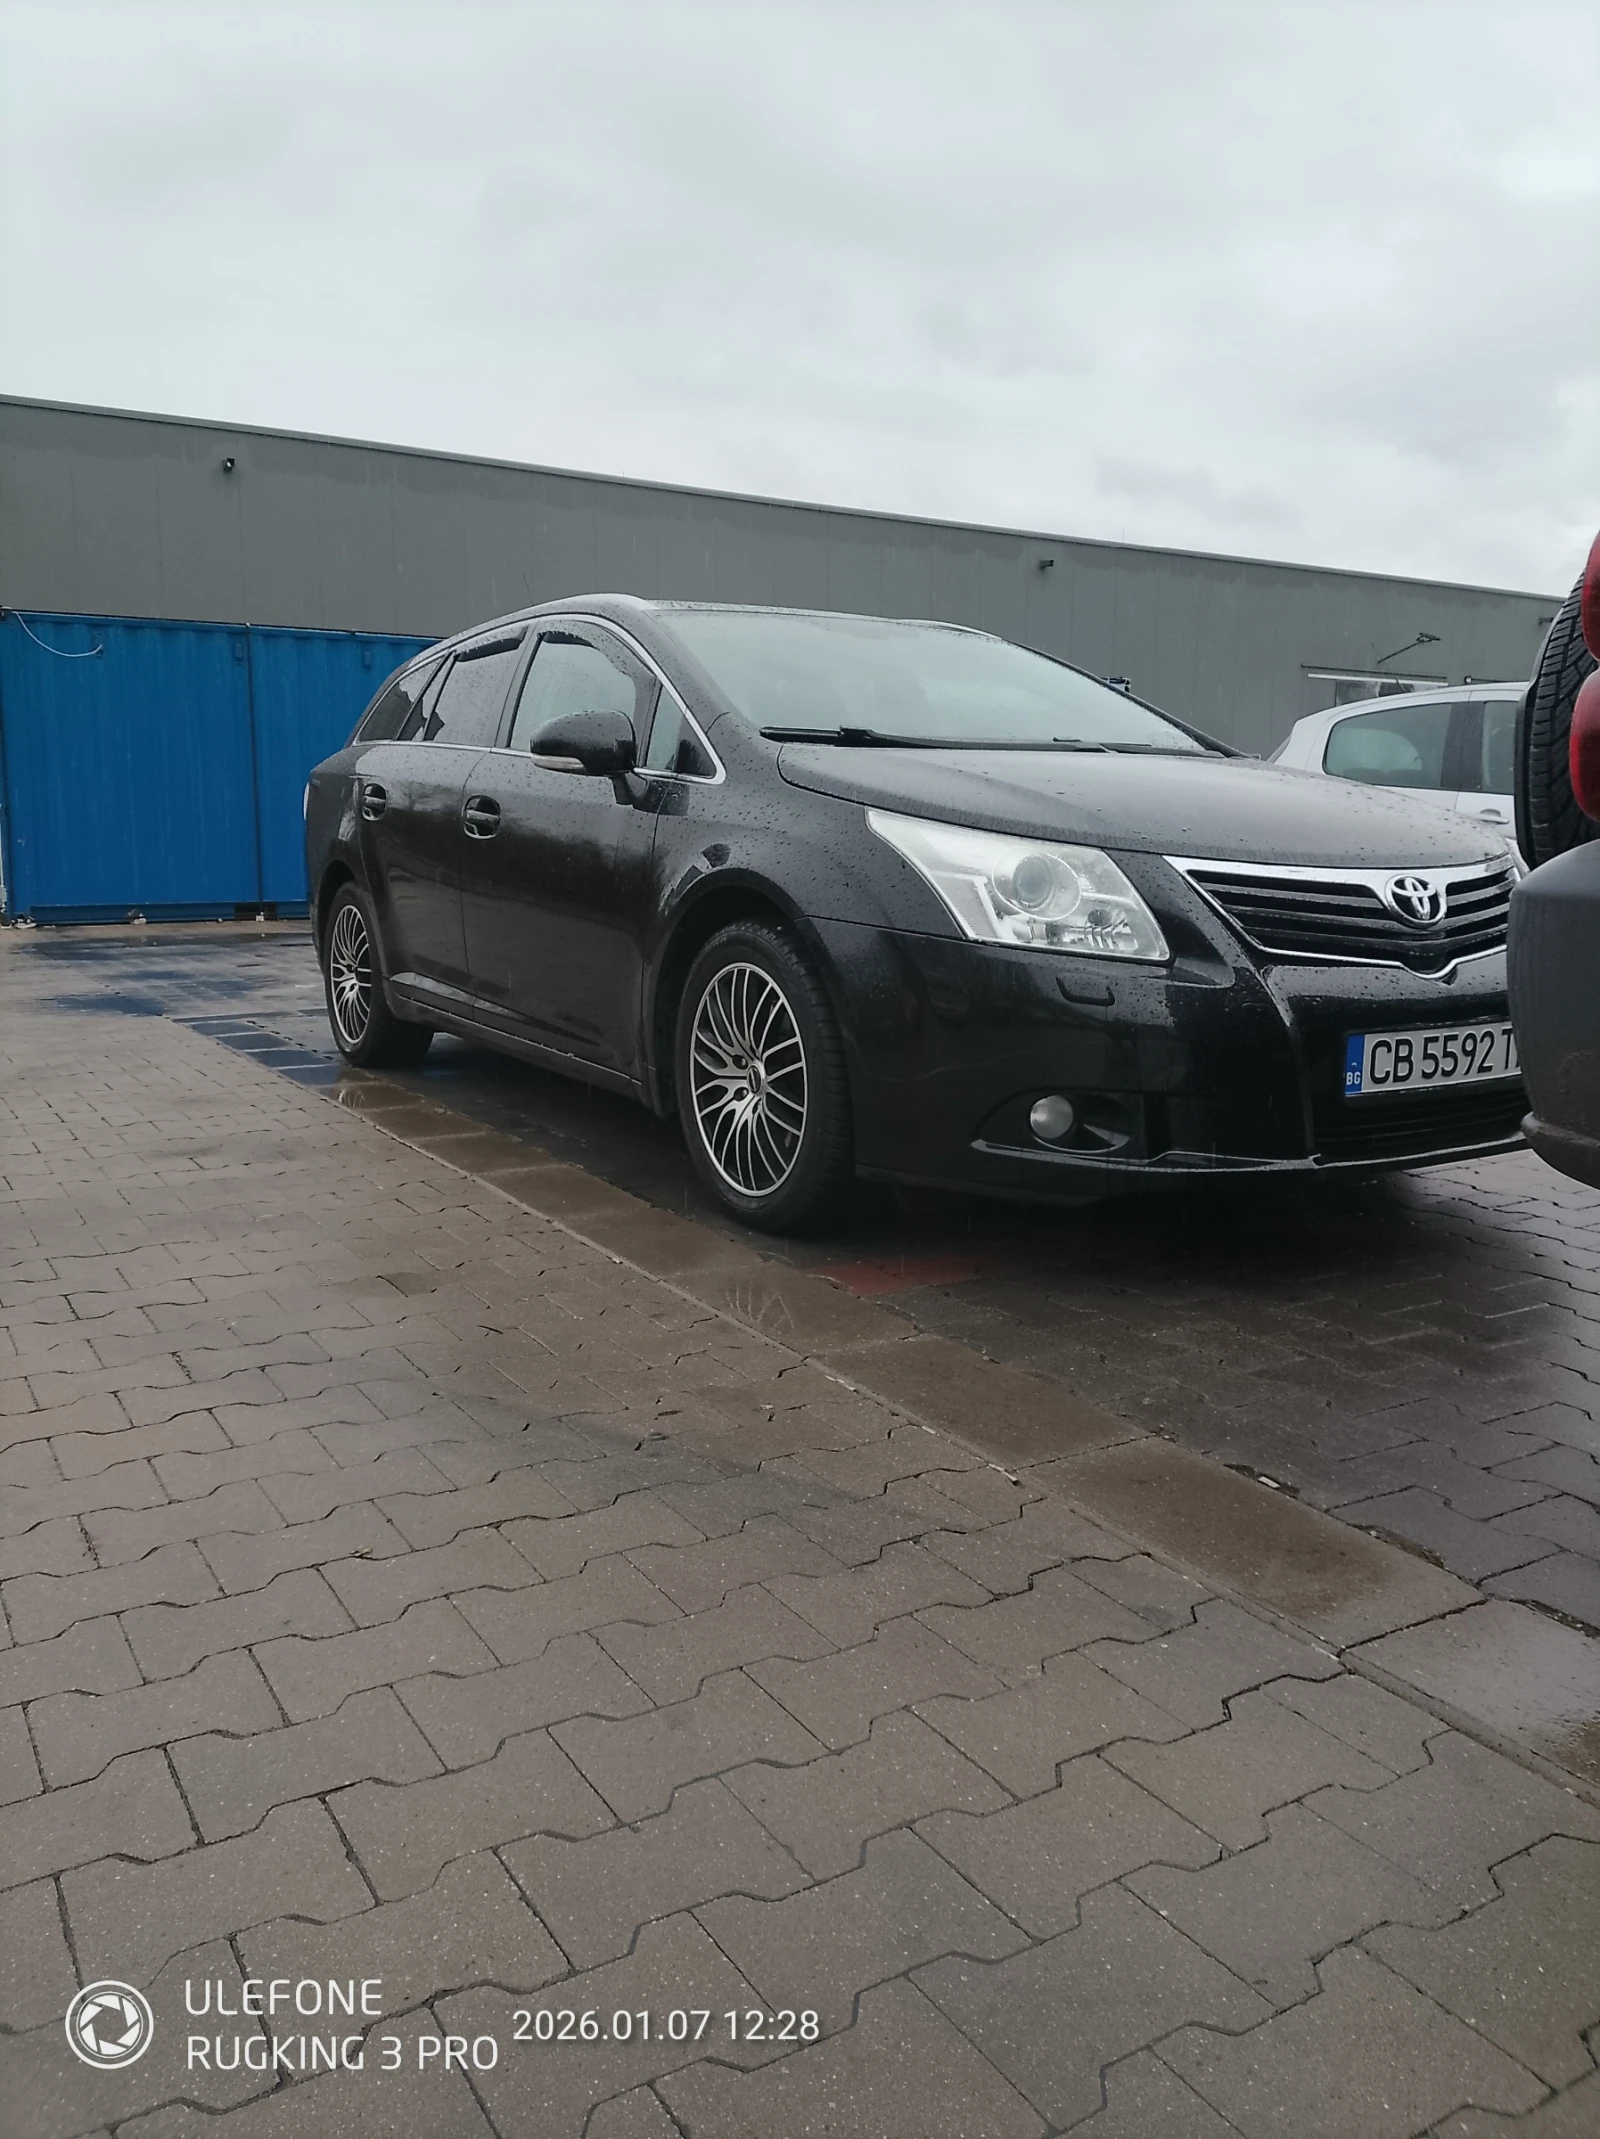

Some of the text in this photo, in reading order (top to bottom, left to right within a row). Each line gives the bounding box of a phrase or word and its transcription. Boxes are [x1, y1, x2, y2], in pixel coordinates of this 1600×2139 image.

[1370, 1026, 1521, 1085] CB 5592 T
[1346, 1072, 1361, 1086] BG
